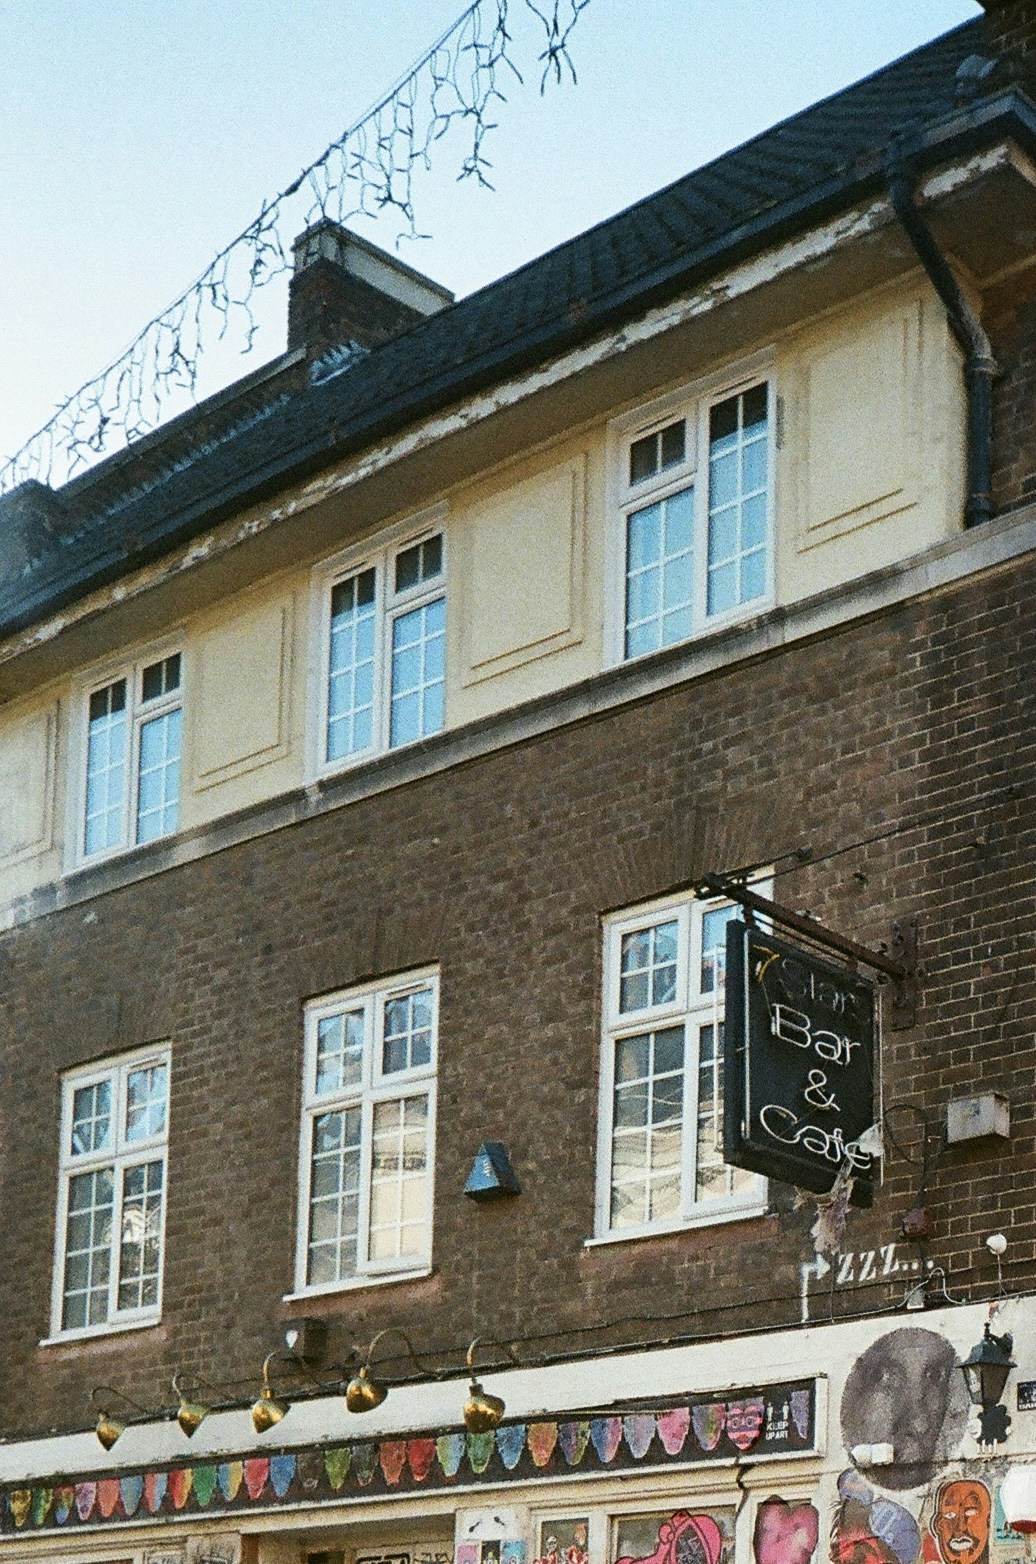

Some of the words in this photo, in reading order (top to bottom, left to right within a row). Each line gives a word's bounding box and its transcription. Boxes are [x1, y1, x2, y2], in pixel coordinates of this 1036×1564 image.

[771, 1003, 861, 1066] Bar
[803, 1068, 840, 1112] &
[766, 1420, 789, 1431] KEEP
[775, 1430, 789, 1439] ART
